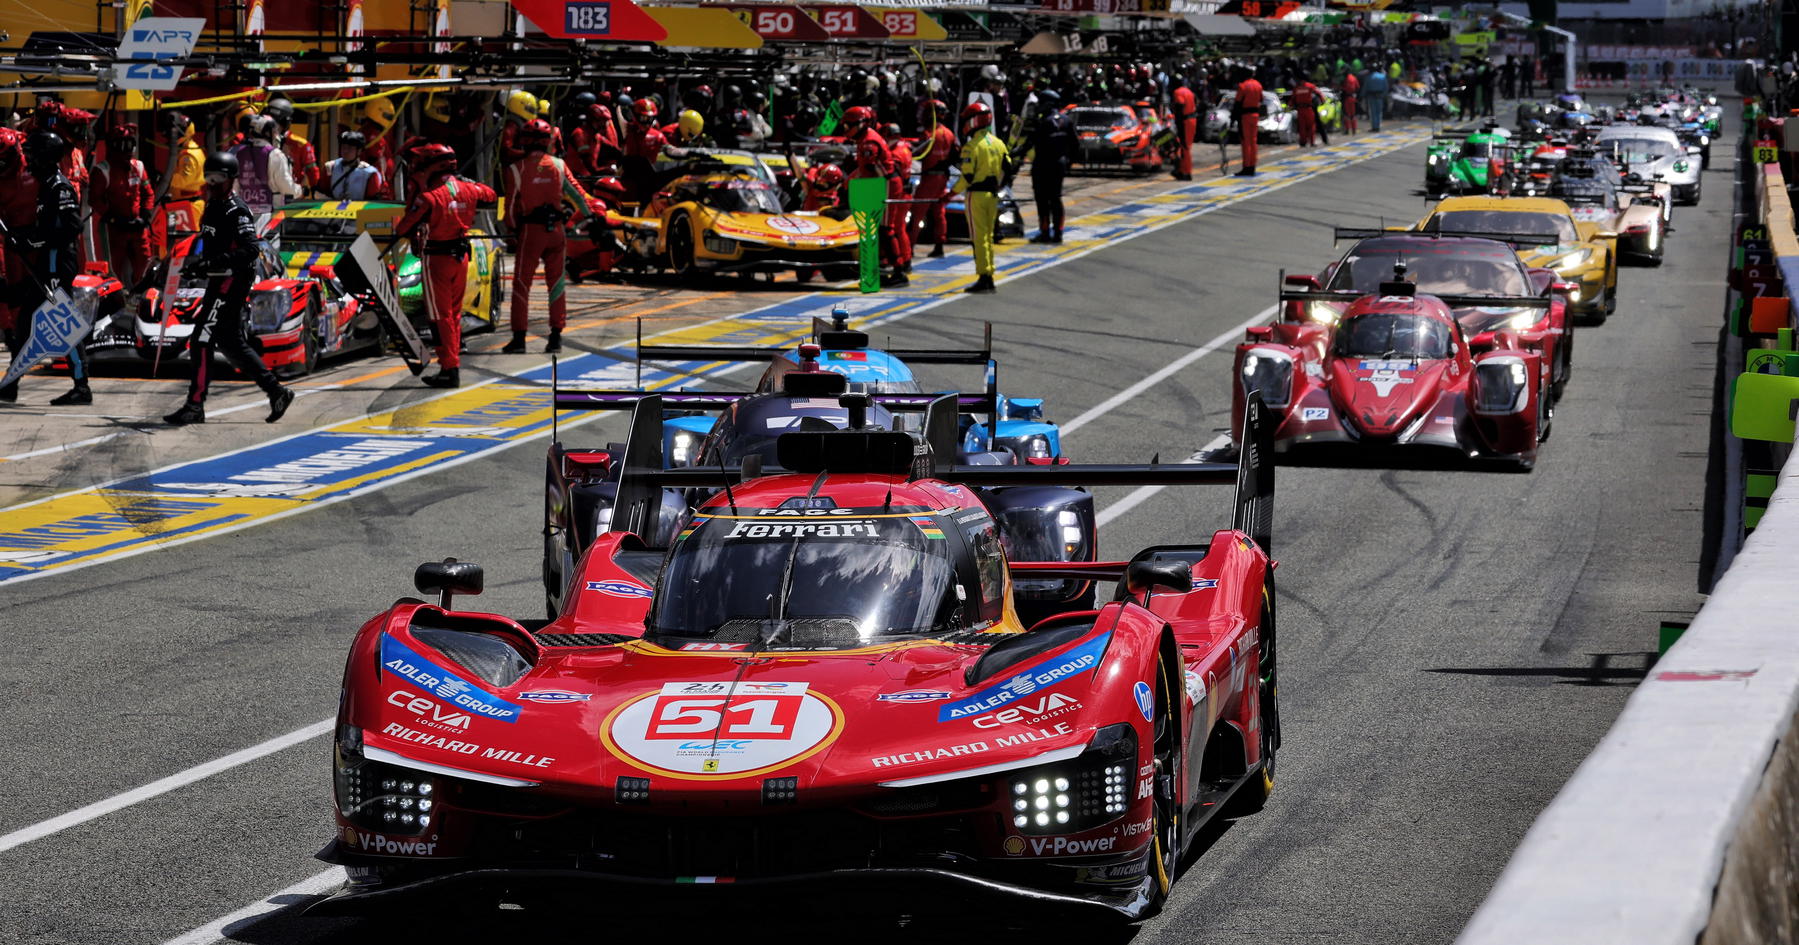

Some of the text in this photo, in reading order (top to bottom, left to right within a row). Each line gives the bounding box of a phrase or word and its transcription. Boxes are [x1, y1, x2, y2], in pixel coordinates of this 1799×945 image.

[567, 7, 608, 29] 183
[758, 12, 794, 33] 50
[824, 11, 857, 32] 51
[885, 13, 916, 34] 83
[147, 30, 193, 43] APR
[126, 52, 178, 79] 25
[47, 301, 81, 337] 25
[37, 320, 65, 347] STOP
[1305, 409, 1327, 418] P2
[226, 438, 435, 483] MICHELIN
[723, 519, 881, 539] Ferrari
[683, 643, 741, 651] HY
[385, 659, 513, 719] ADLER GROUP
[950, 654, 1095, 718] ADLER GROUP
[1139, 685, 1152, 714] hp
[656, 699, 785, 734] 51
[1026, 703, 1083, 725] LOGISTICS
[415, 717, 464, 735] LOGISTICS
[382, 722, 556, 768] RICHARD MILLE
[678, 740, 753, 750] WEC
[871, 721, 1073, 768] RICHARD MILLE
[359, 832, 437, 855] V-Power
[1031, 836, 1116, 855] V-Power
[1110, 861, 1147, 877] MICHELIN
